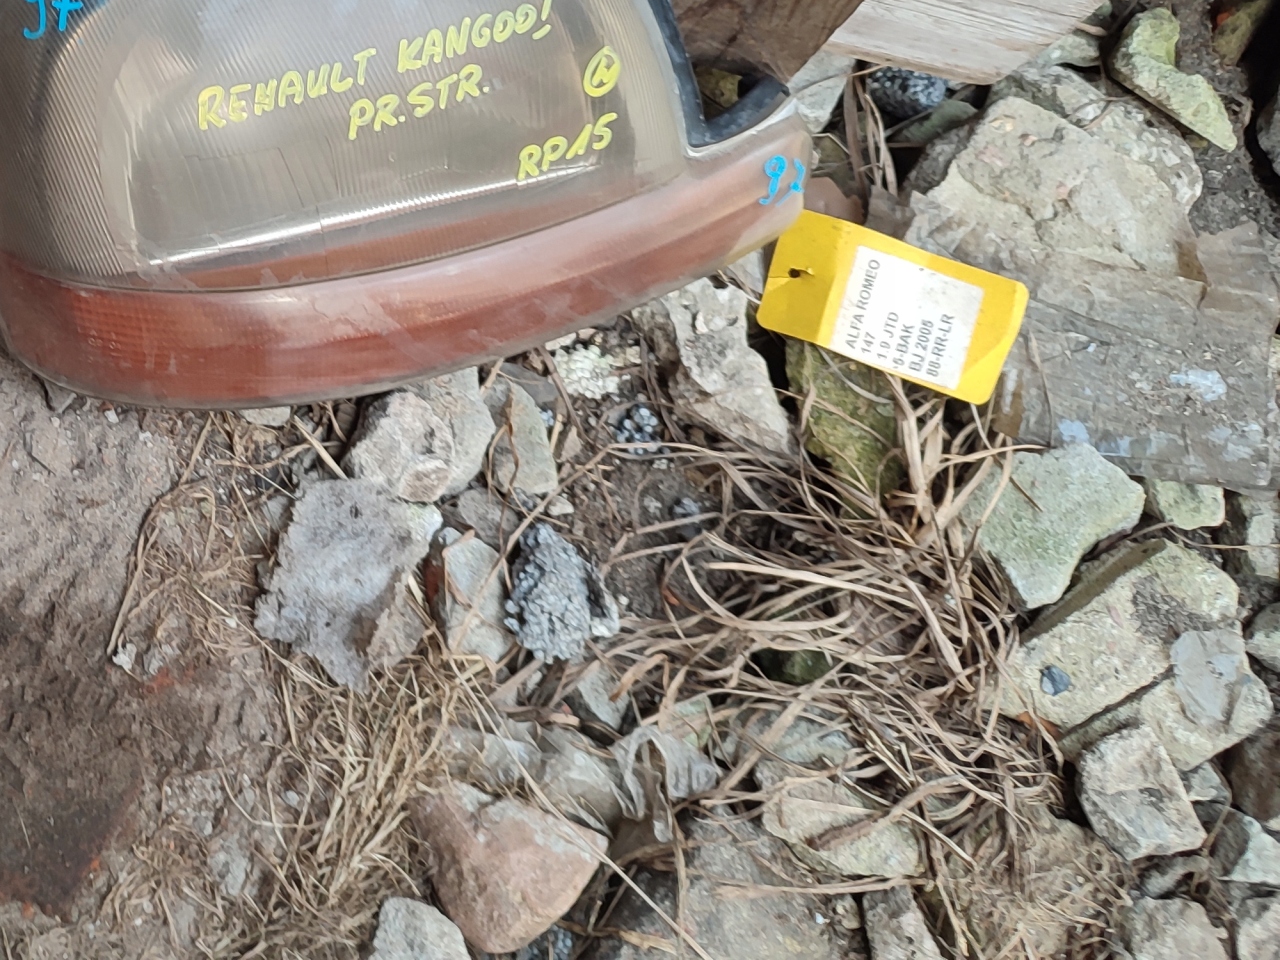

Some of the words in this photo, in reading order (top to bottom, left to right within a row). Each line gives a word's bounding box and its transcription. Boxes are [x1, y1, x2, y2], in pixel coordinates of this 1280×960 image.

[198, 48, 377, 131] RENAULT
[845, 314, 865, 349] ALFA
[856, 259, 881, 310] ROMEO
[883, 312, 899, 339] JTD
[861, 331, 876, 354] 147
[876, 340, 891, 360] 1.9
[908, 353, 925, 372] BJ
